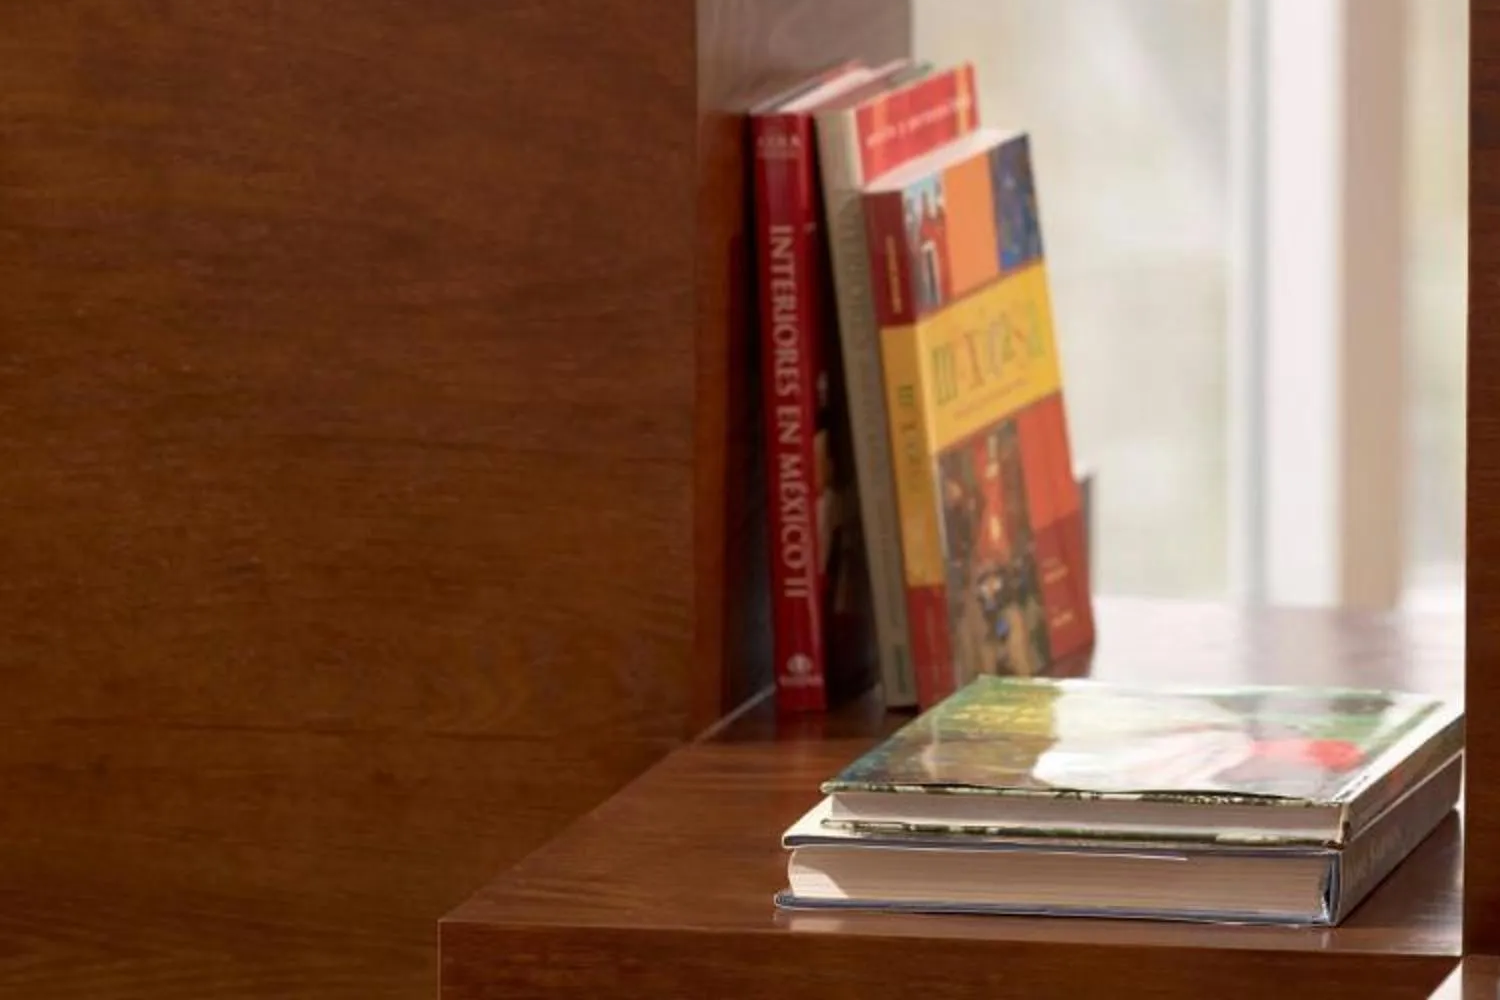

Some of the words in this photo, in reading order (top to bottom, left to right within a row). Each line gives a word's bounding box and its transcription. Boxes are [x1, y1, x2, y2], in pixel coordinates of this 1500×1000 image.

[769, 225, 800, 397] INTERIORES
[775, 406, 802, 444] EN
[779, 453, 810, 569] MÉXICO
[783, 577, 809, 598] II
